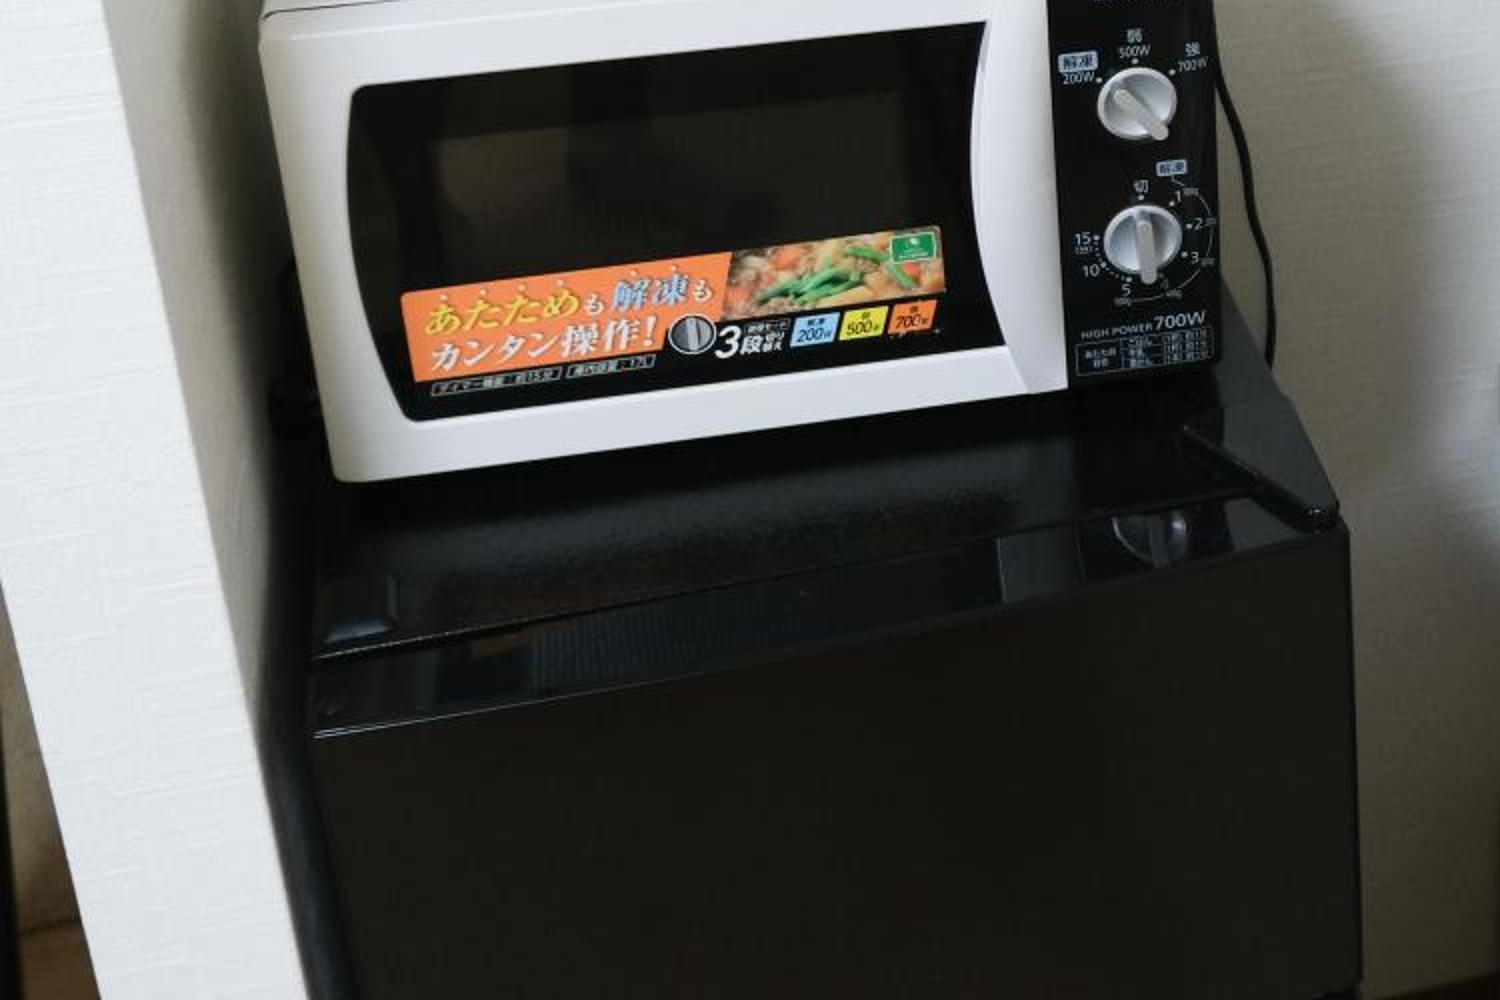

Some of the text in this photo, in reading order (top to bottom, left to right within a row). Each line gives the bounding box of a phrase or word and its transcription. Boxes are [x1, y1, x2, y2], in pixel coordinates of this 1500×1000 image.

[1175, 191, 1182, 202] 1
[1075, 232, 1091, 246] 15
[1191, 252, 1199, 264] 3
[1083, 264, 1100, 278] 10
[1122, 284, 1131, 297] 5
[1082, 309, 1206, 341] HIGH POWER 700W
